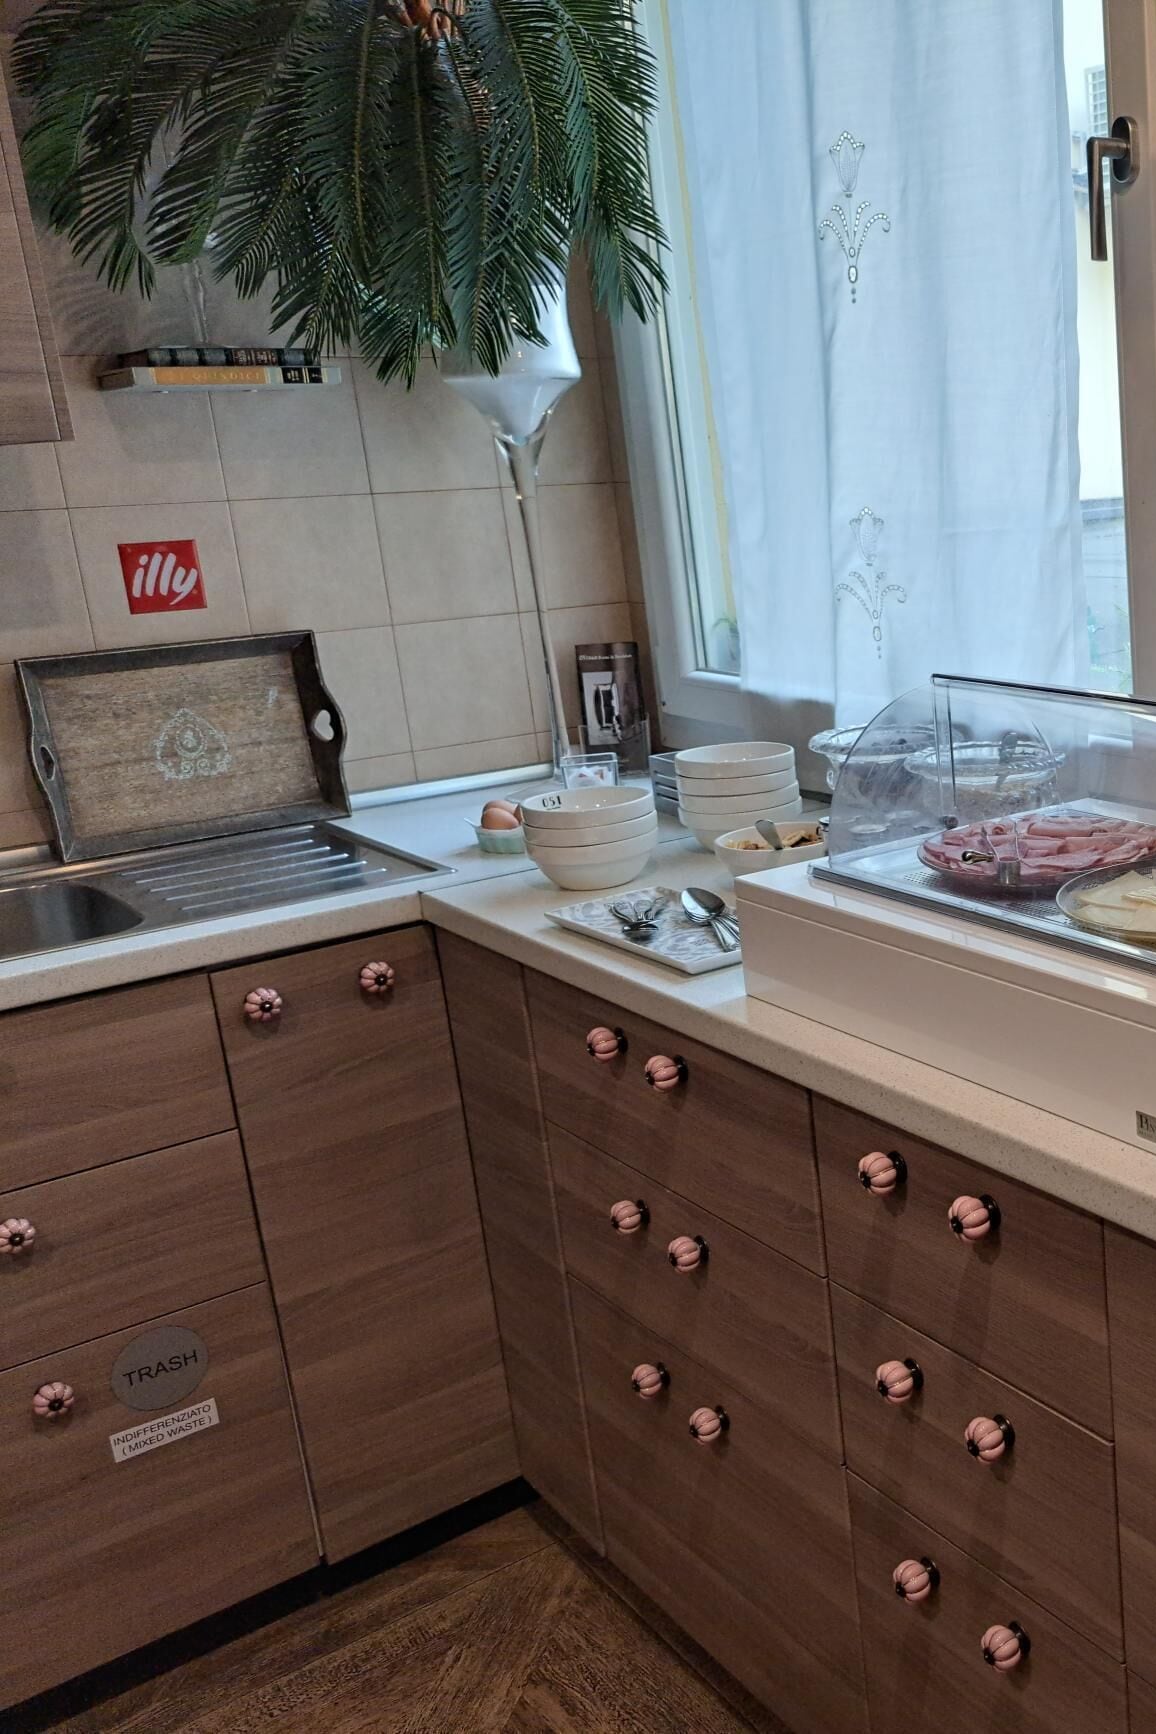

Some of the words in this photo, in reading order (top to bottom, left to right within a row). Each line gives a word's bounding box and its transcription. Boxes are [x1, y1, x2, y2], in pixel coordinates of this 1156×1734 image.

[132, 552, 198, 606] illy
[122, 1349, 199, 1387] TRASH
[113, 1404, 211, 1446] INDIFFERENZIATO
